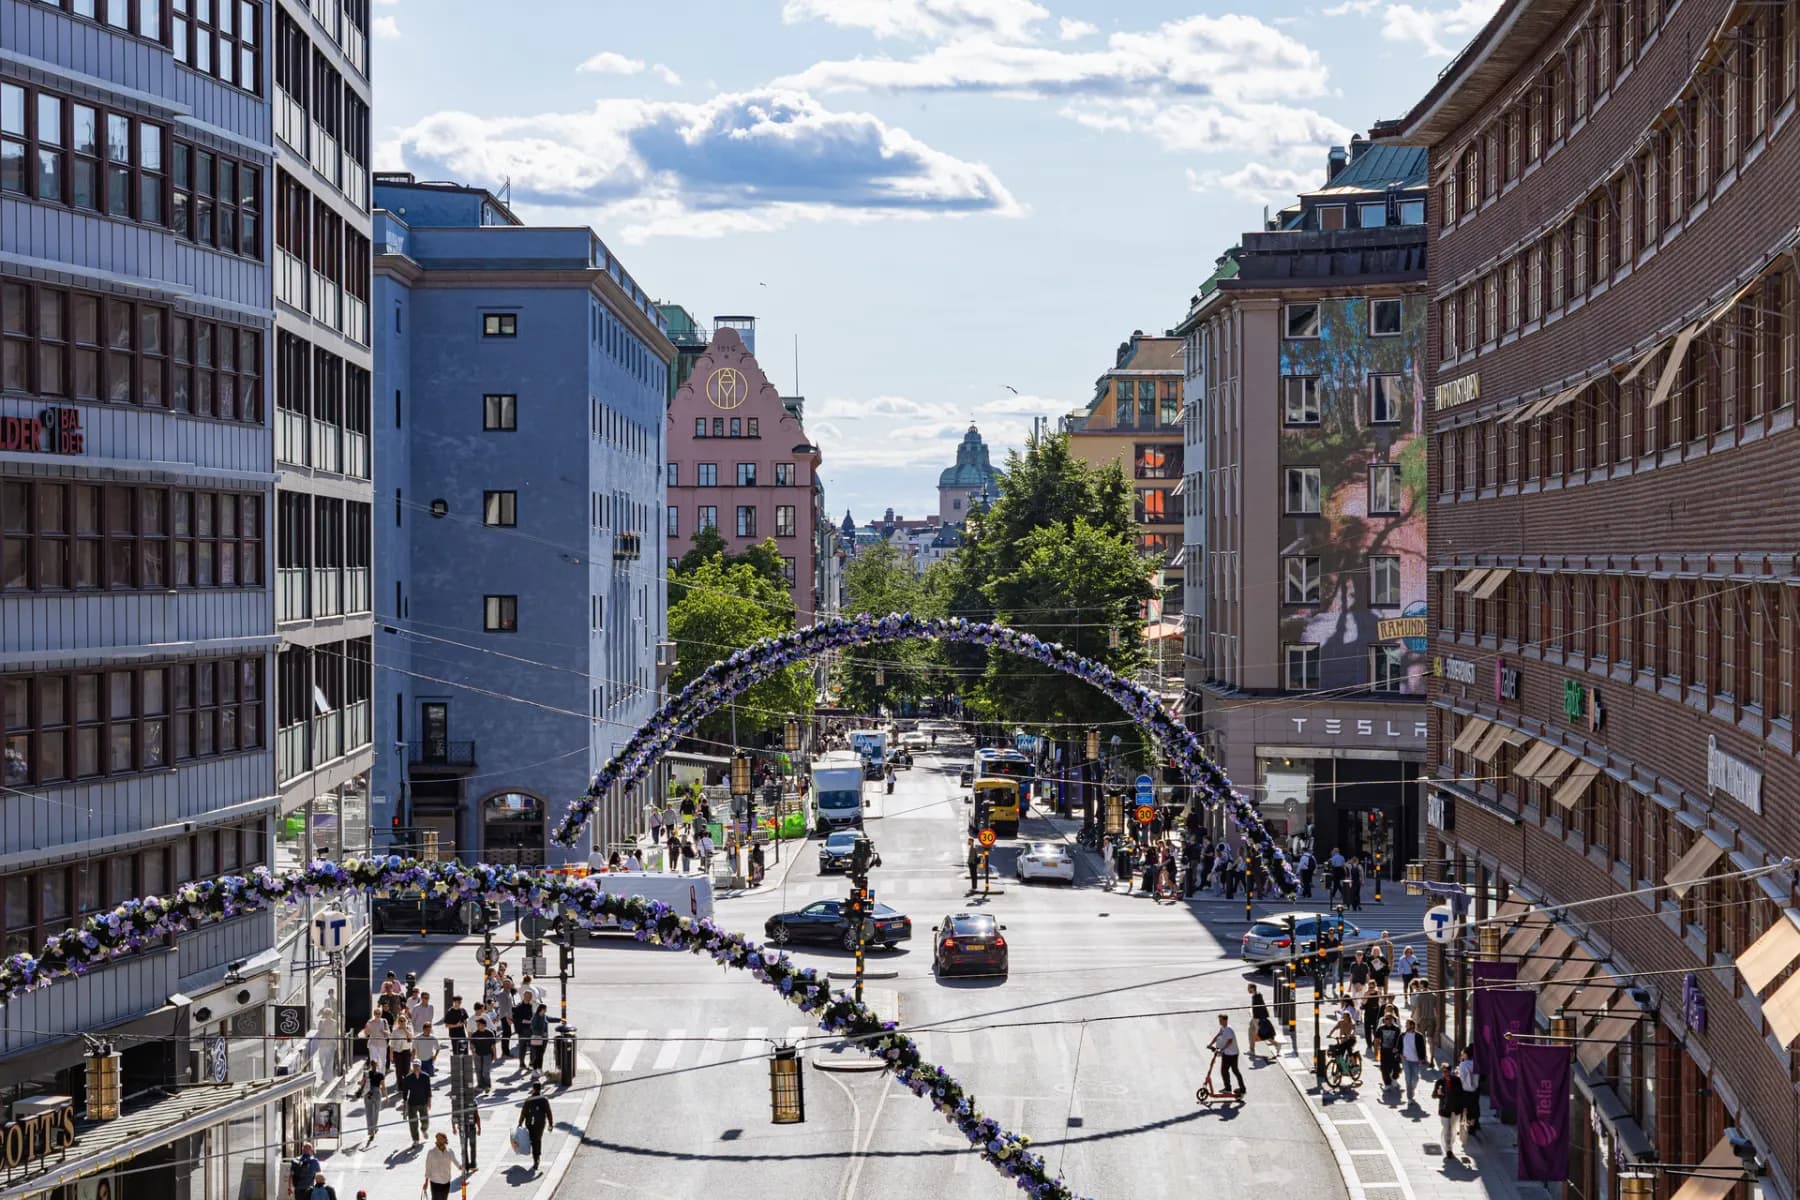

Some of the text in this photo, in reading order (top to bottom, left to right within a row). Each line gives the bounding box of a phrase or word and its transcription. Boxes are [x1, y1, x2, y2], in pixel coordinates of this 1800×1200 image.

[1291, 718, 1427, 738] TESLA
[1140, 810, 1151, 819] 30
[983, 833, 993, 842] 30
[1431, 913, 1449, 938] T
[280, 1008, 300, 1034] 3
[214, 1036, 227, 1082] 3
[1536, 1080, 1552, 1117] Telia
